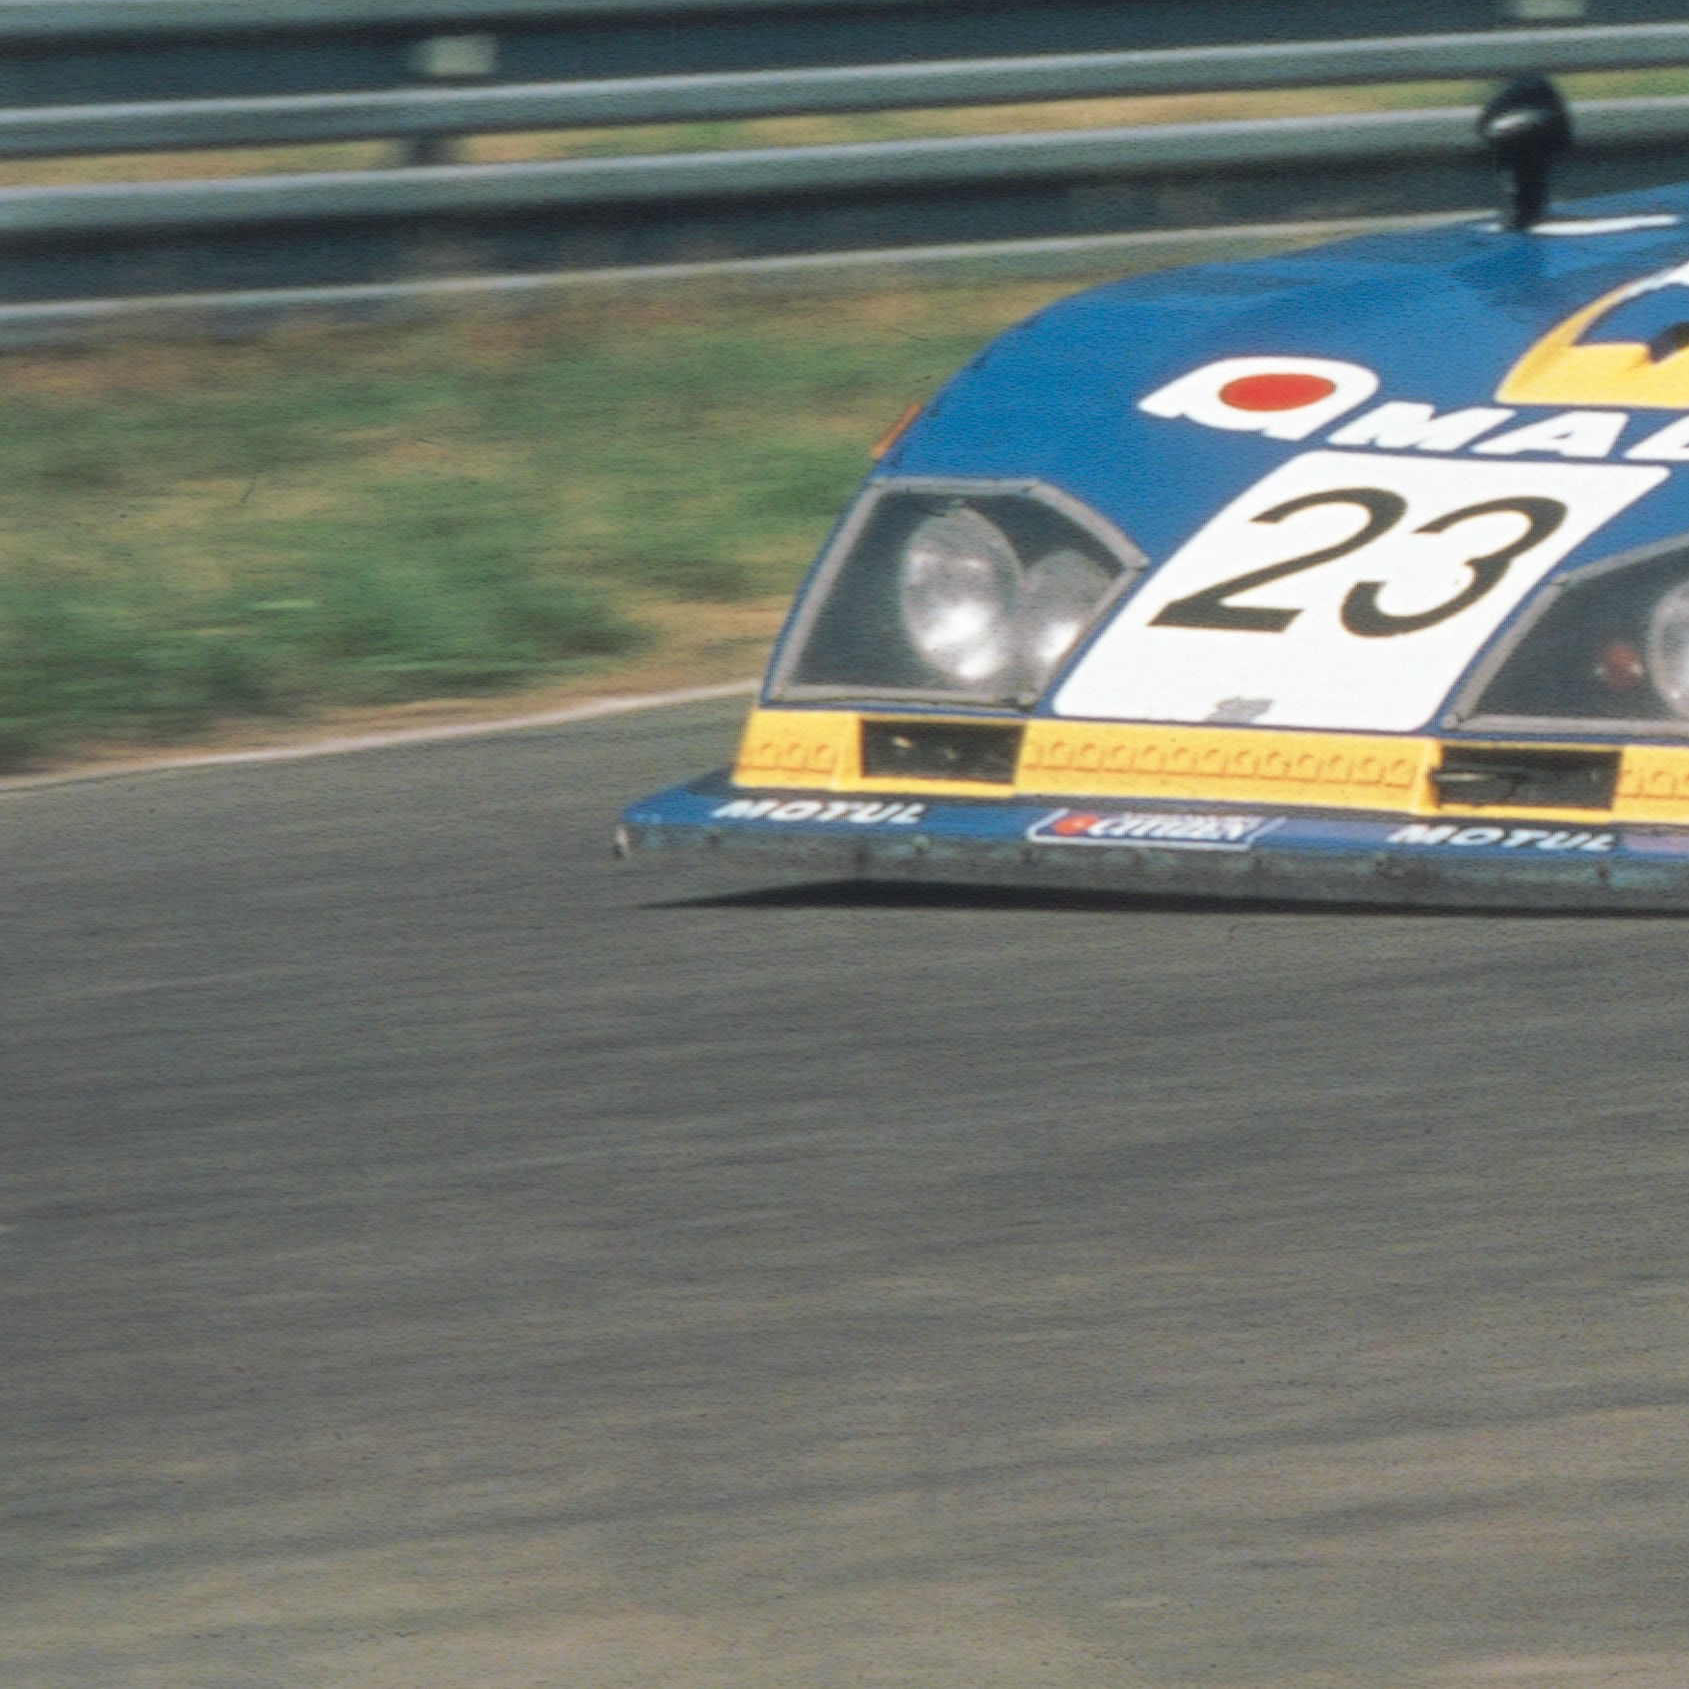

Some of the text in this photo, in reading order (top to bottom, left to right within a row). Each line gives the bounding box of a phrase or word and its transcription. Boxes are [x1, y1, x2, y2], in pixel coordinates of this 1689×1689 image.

[1148, 486, 1567, 638] 23
[711, 798, 927, 825] MOTUL
[1386, 823, 1617, 852] MOTUL
